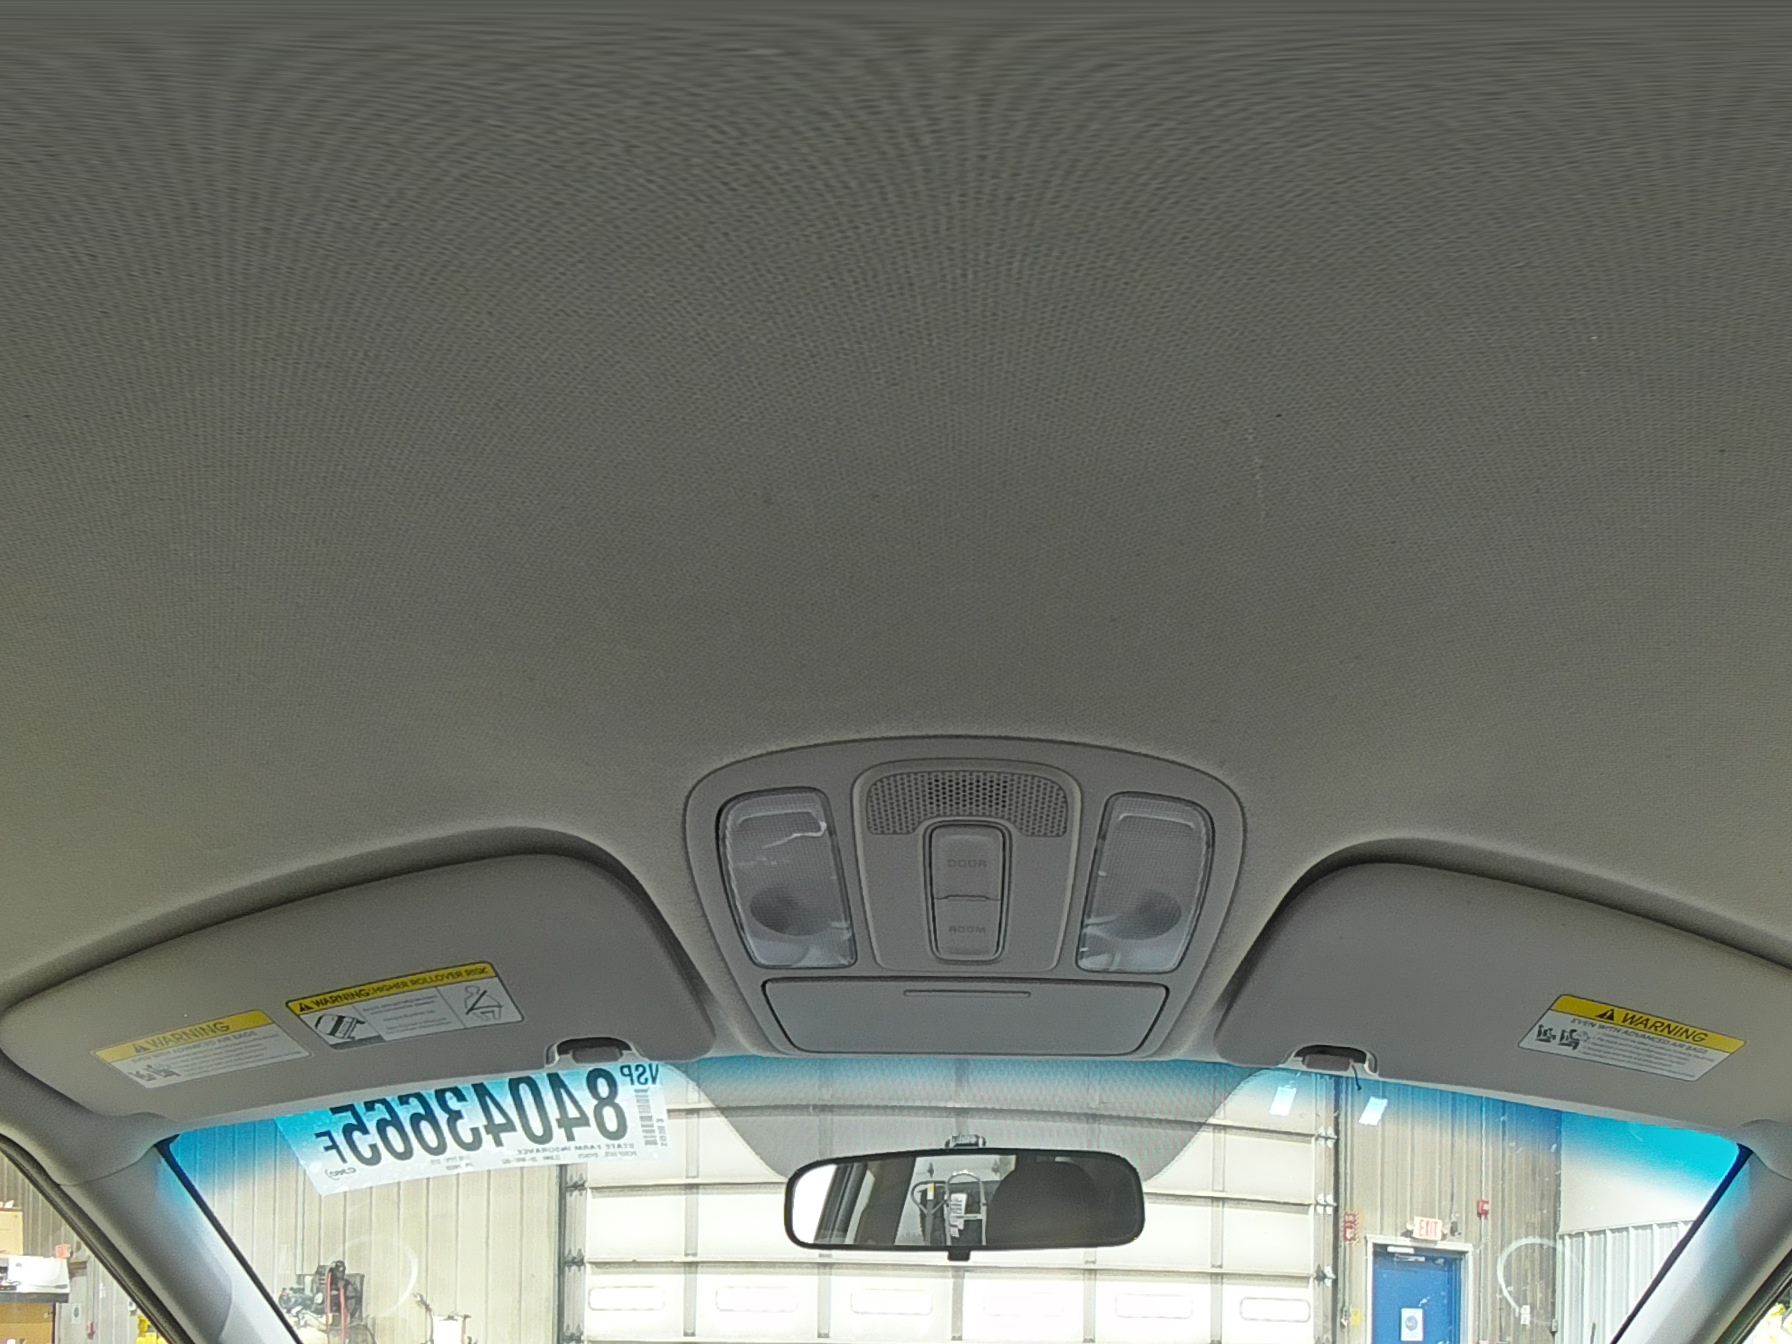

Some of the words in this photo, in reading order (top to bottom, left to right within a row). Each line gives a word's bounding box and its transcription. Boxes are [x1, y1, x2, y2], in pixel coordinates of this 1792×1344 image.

[947, 859, 988, 868] DOOR
[949, 925, 986, 934] ROOM
[145, 1021, 230, 1049] WARNING
[1621, 1012, 1709, 1043] WARNING
[1622, 1028, 1671, 1045] ADVANCED
[1418, 1220, 1438, 1238] EXIT
